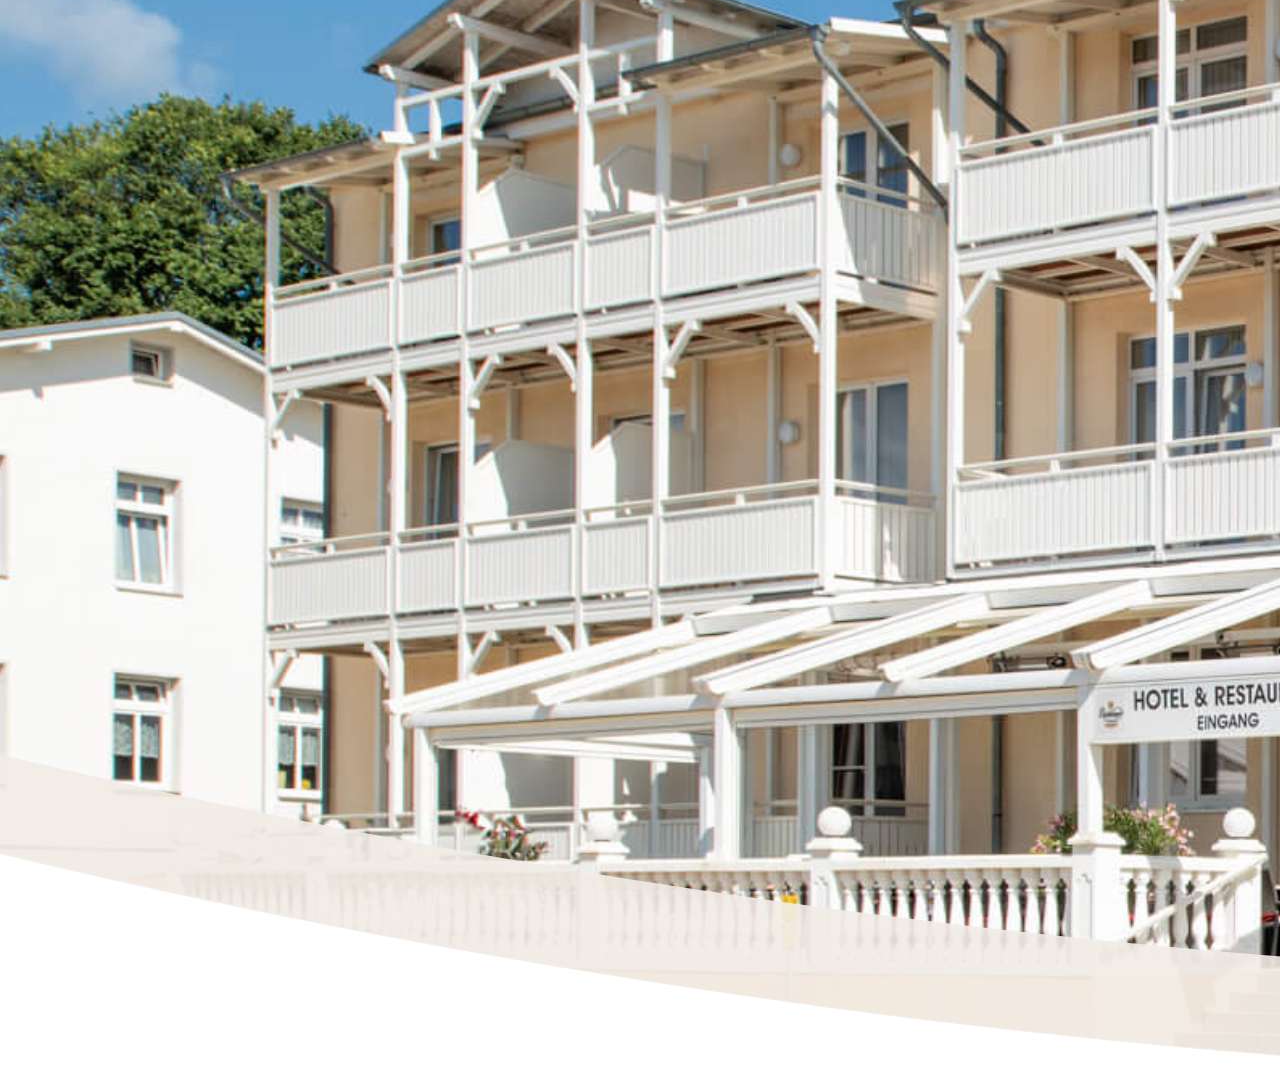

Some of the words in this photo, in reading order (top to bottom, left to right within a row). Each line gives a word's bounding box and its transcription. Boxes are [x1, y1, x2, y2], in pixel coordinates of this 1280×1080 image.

[1133, 687, 1189, 711] HOTEL
[1194, 686, 1208, 708] &
[1196, 711, 1260, 731] EINGANG
